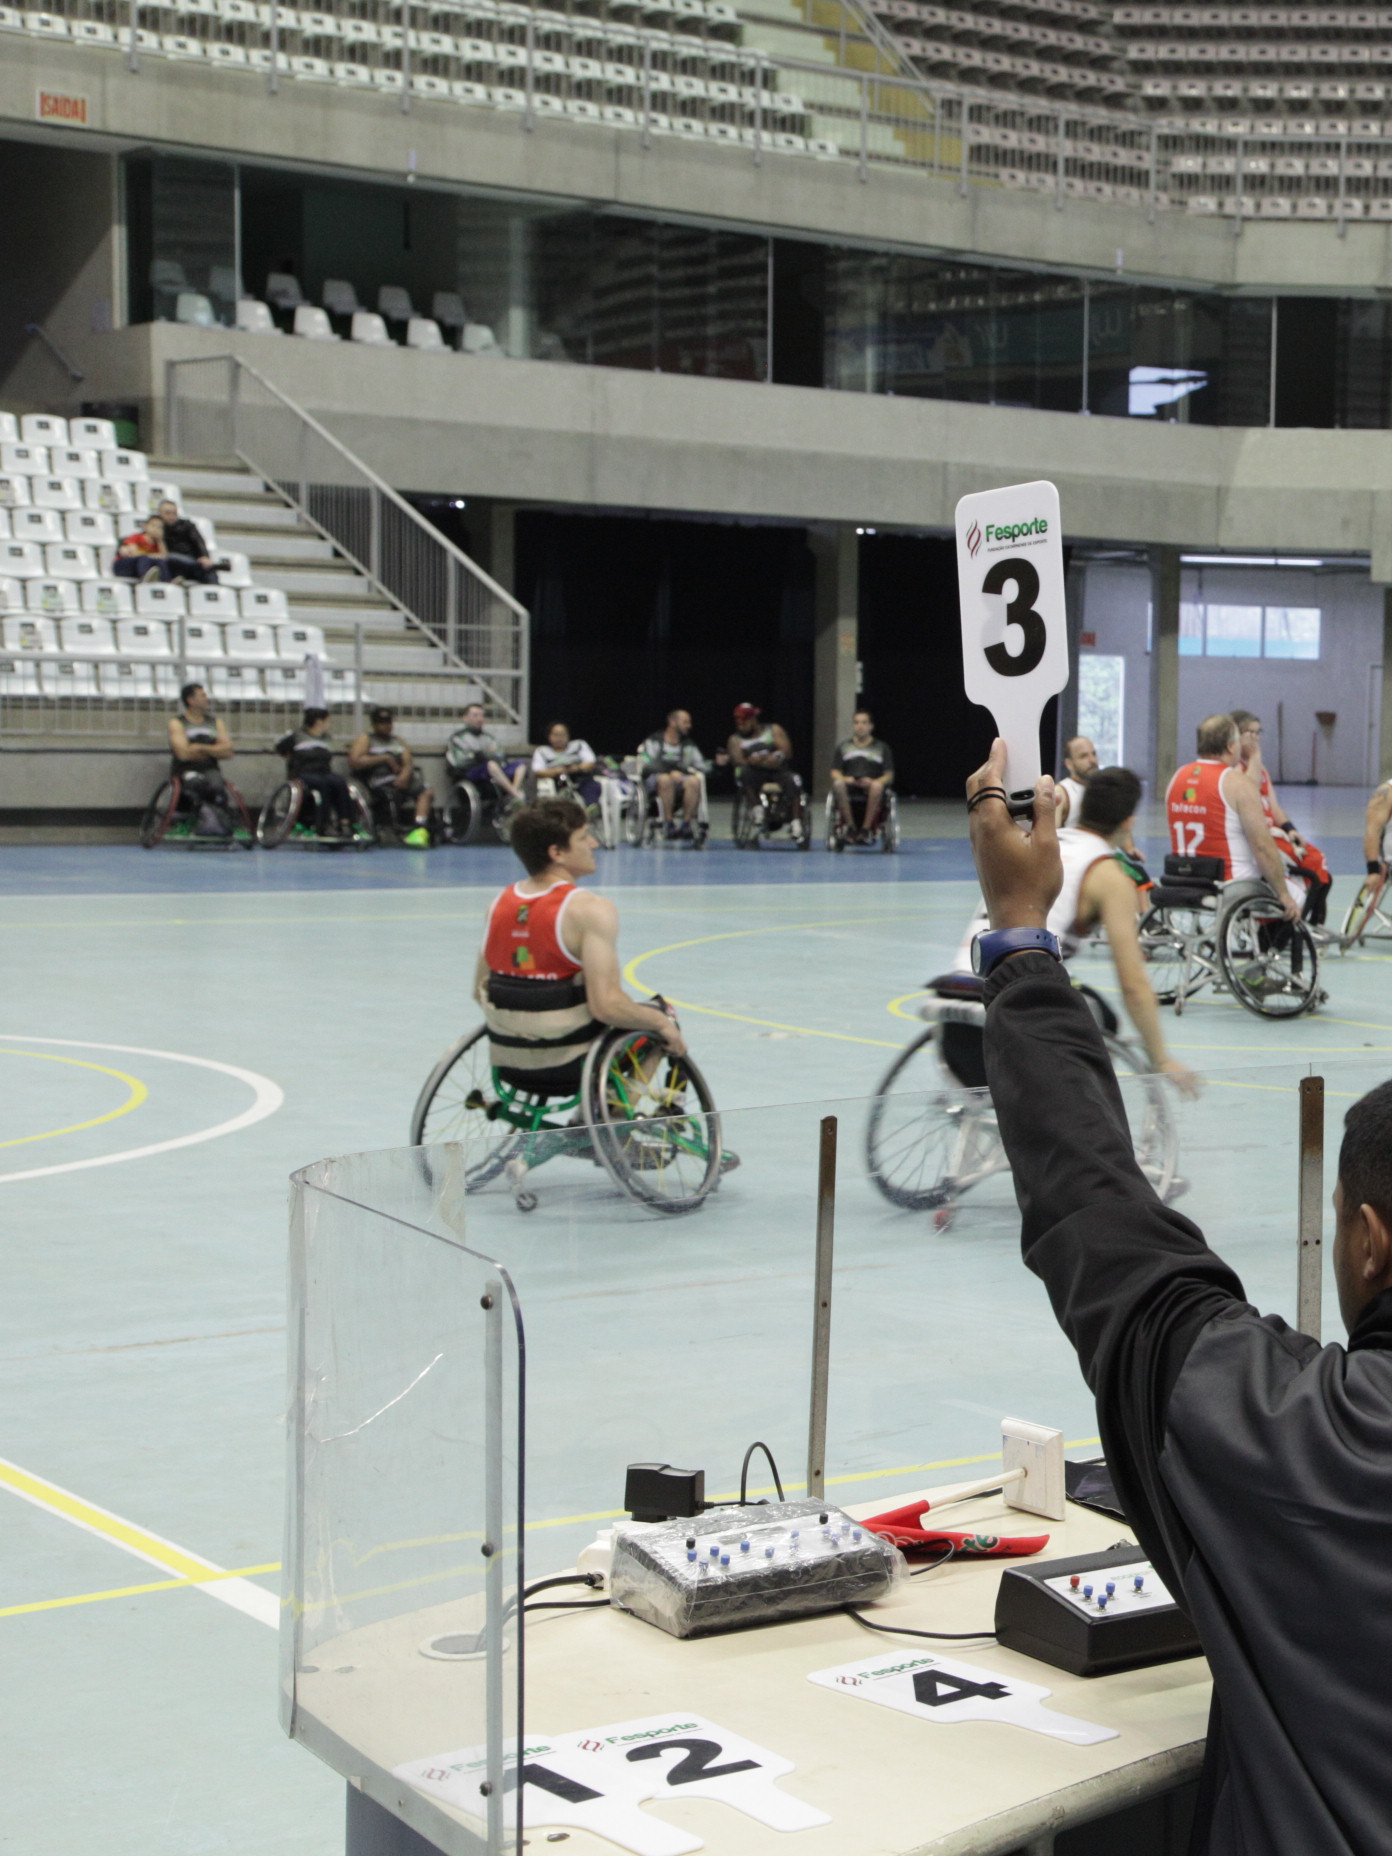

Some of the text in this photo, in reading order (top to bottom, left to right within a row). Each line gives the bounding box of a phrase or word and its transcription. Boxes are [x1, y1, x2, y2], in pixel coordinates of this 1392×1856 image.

[985, 517, 1048, 543] Fesporte
[982, 557, 1047, 677] 3
[858, 1656, 935, 1679] Fesporte
[912, 1669, 1013, 1707] 4
[605, 1722, 698, 1744] Fesporte
[626, 1738, 763, 1786] 2
[501, 1763, 606, 1804] 1
